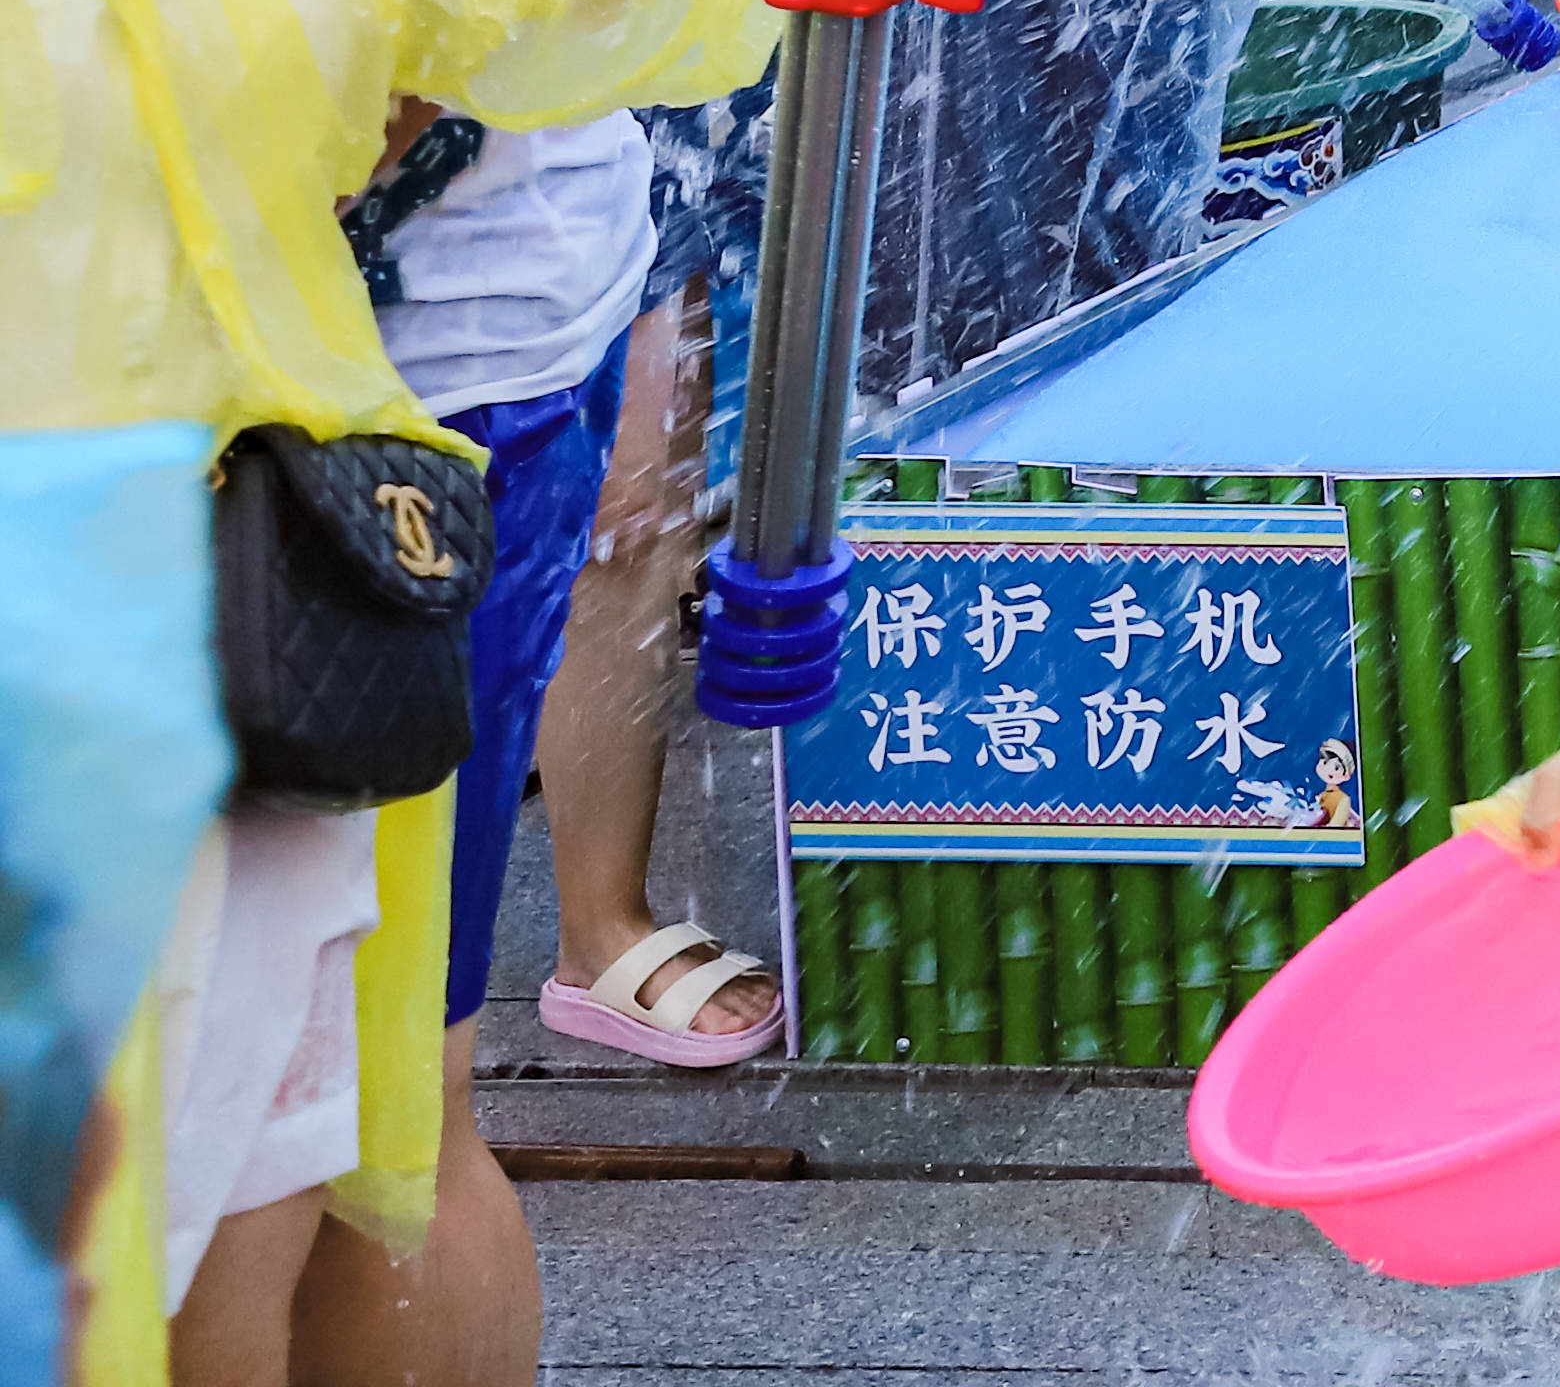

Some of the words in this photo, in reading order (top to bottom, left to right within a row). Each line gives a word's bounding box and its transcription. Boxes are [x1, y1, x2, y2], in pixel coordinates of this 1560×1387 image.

[850, 583, 1282, 672] 保护手机
[861, 685, 1285, 774] 注意防水
